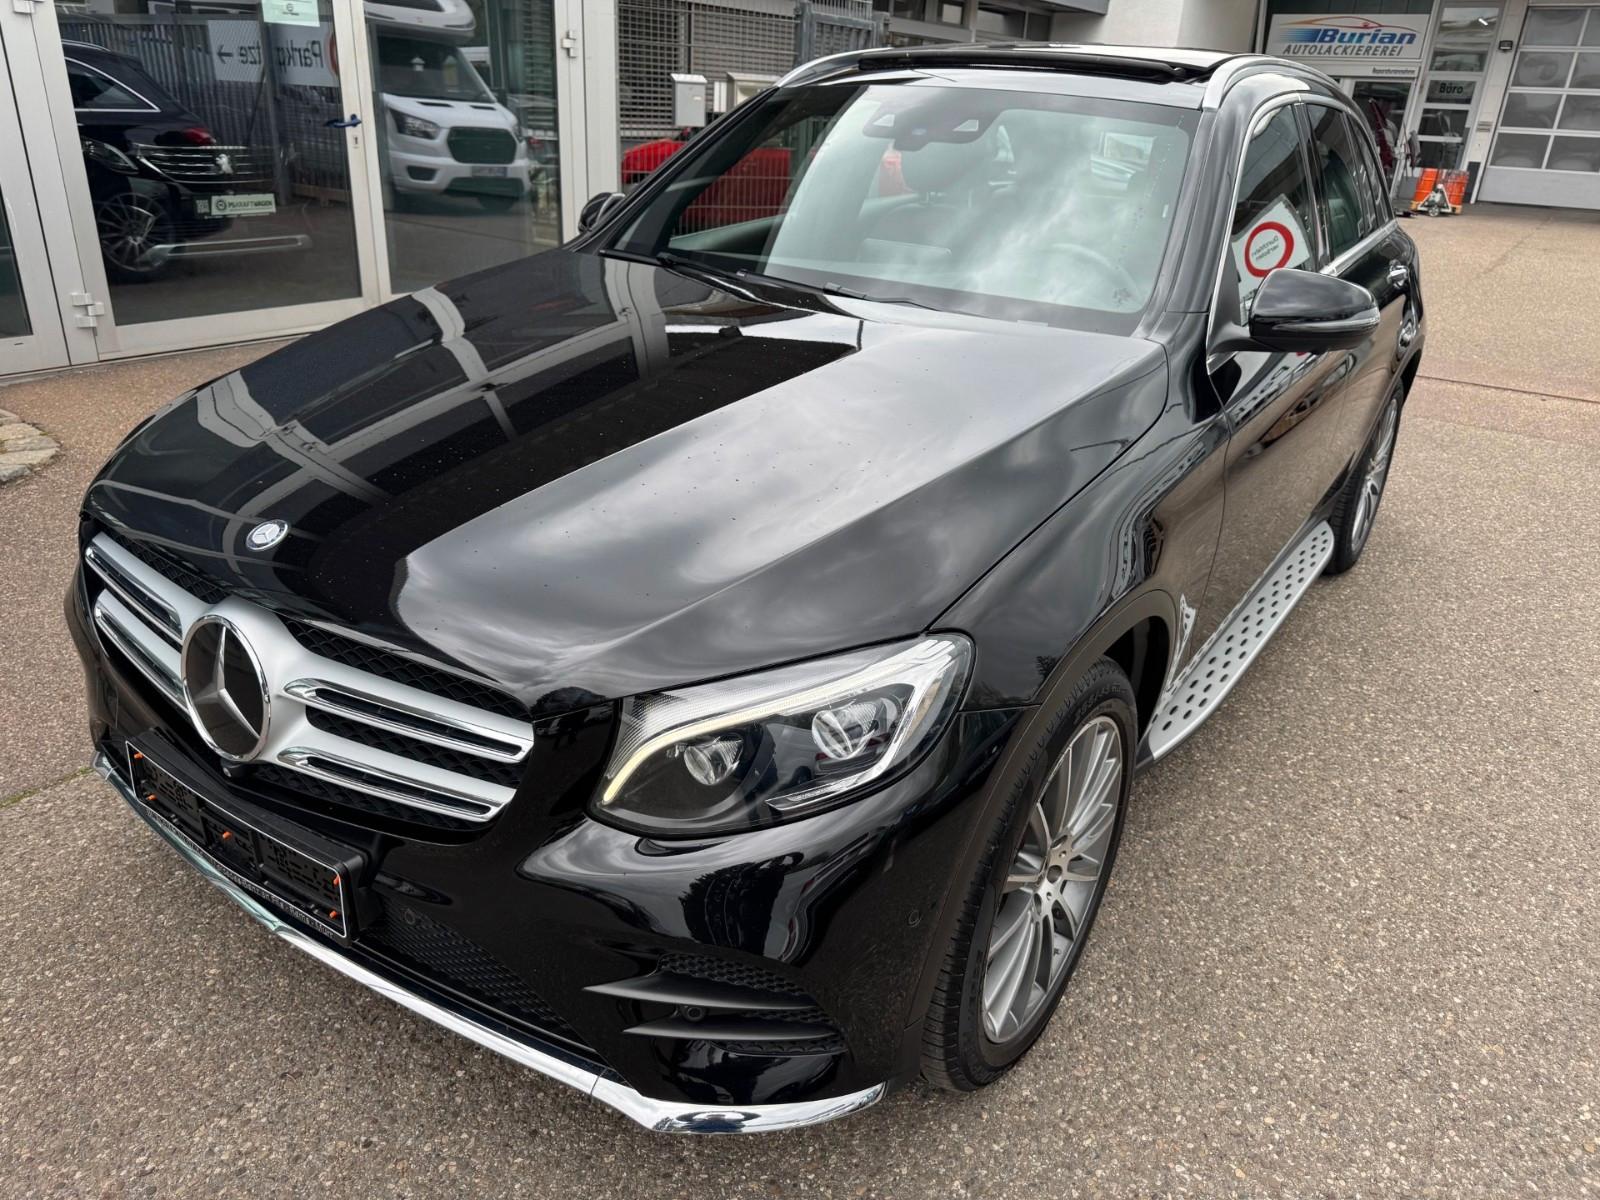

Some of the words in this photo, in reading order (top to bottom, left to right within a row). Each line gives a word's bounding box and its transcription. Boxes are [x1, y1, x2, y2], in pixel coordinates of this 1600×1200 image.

[1316, 28, 1417, 45] Burian
[1282, 44, 1404, 57] AUTOLACKIEREREI
[1439, 82, 1464, 95] Büro
